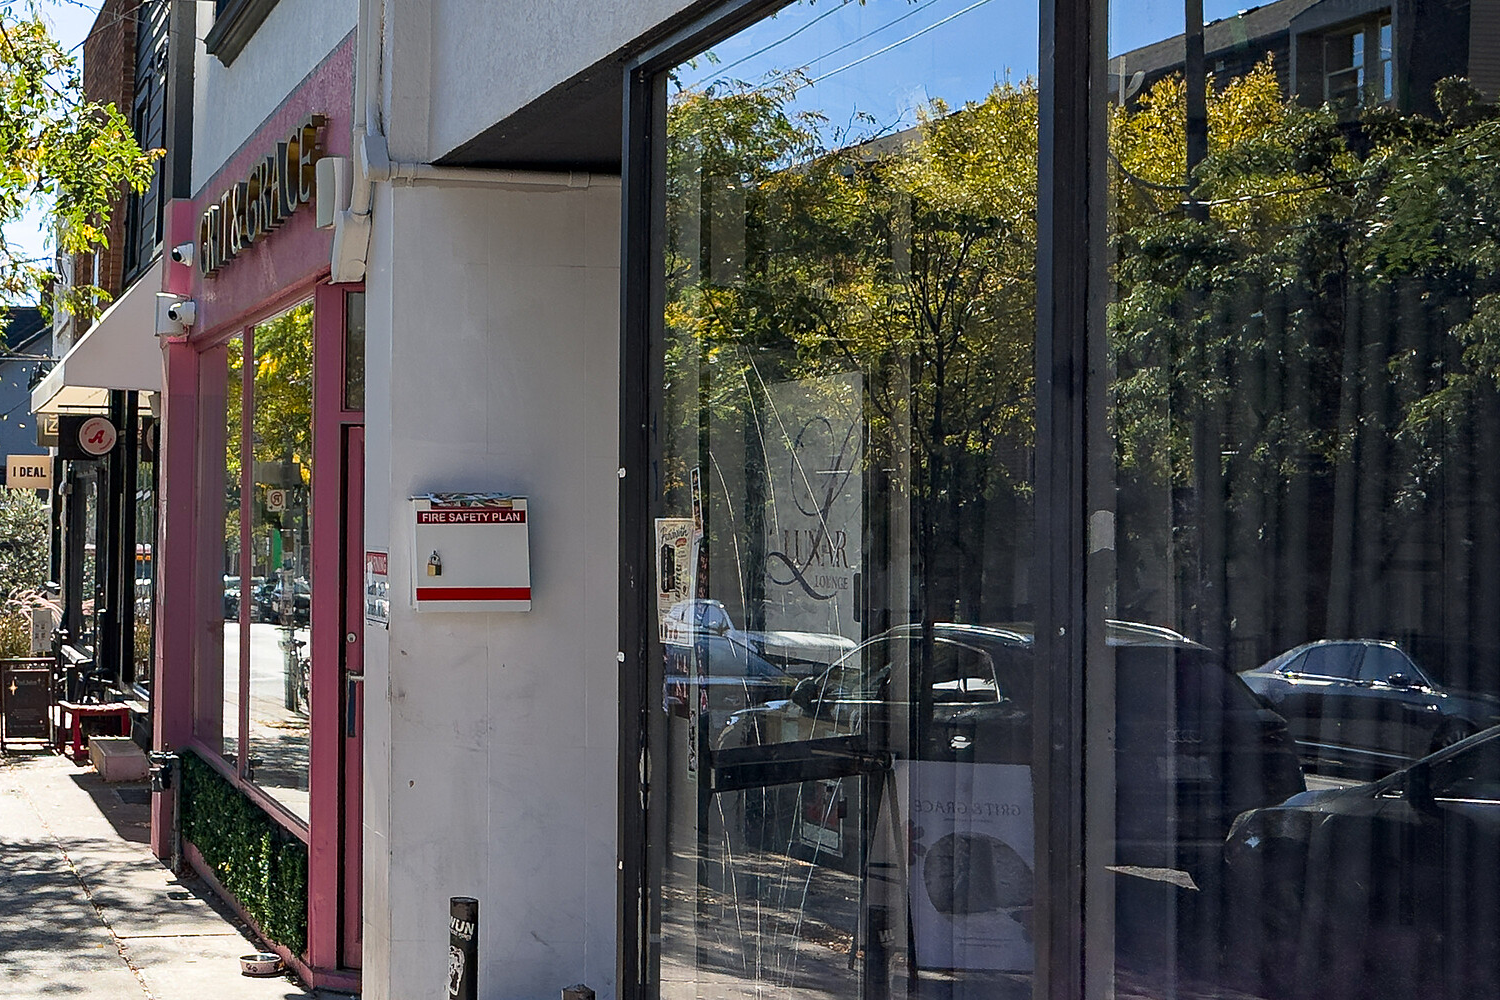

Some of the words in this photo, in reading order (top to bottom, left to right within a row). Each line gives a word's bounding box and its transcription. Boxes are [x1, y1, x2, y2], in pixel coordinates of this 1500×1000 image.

[19, 466, 47, 478] DEAL
[422, 512, 446, 523] FIRE
[448, 512, 490, 523] SAFETY
[492, 512, 521, 522] PLAN
